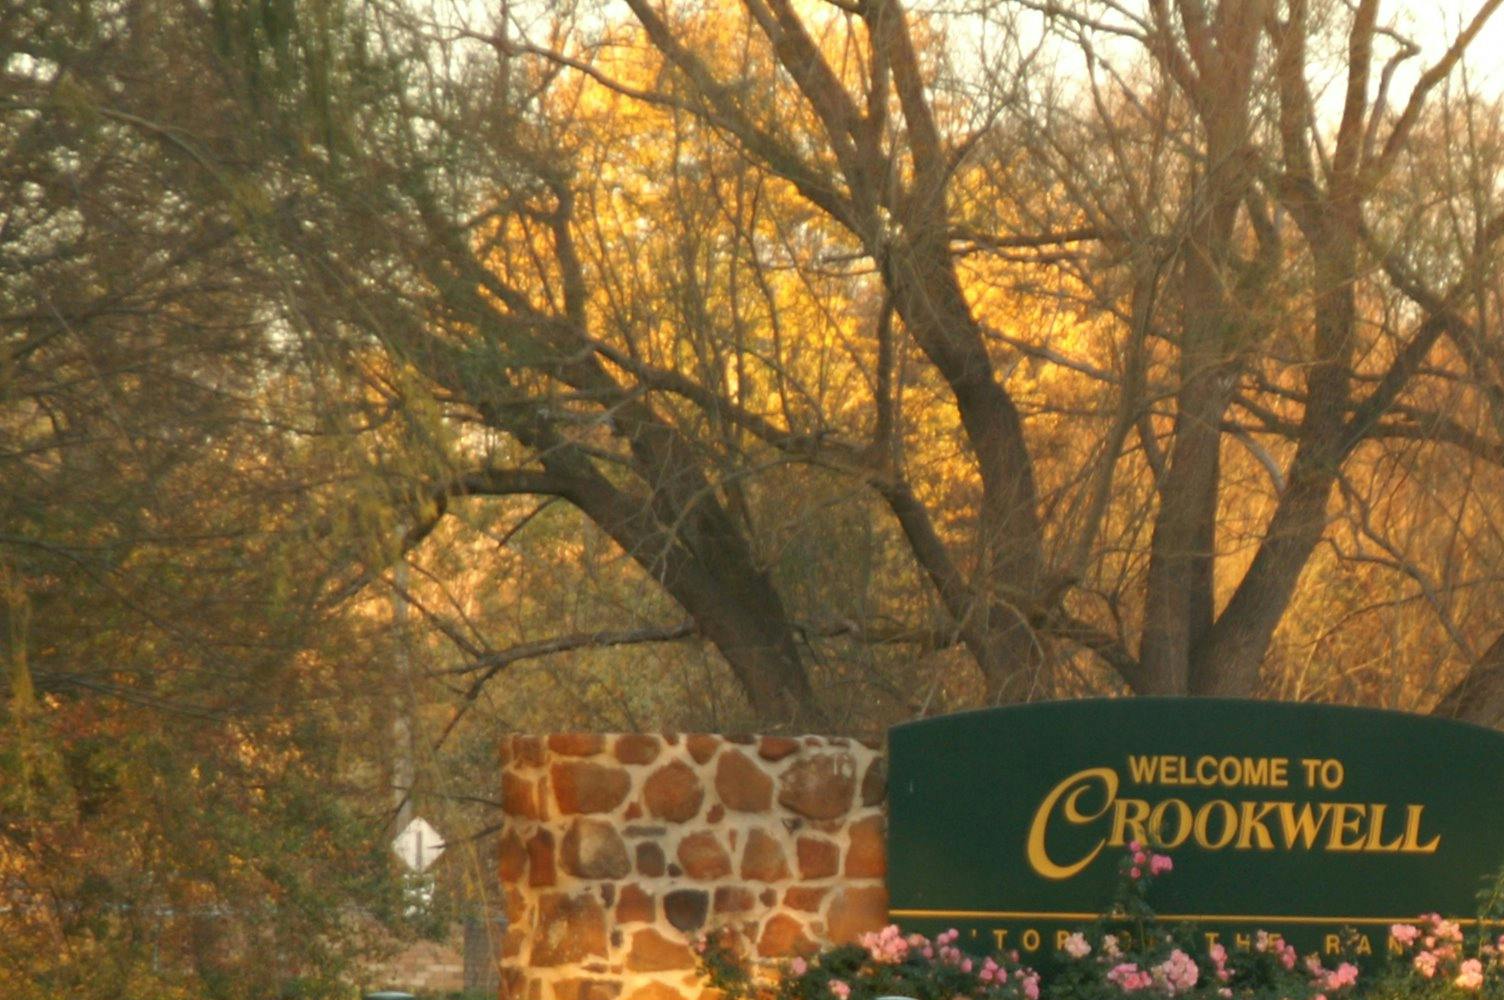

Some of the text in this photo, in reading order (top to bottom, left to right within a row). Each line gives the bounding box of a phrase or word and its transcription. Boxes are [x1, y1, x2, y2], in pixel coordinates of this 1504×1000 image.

[1128, 755, 1344, 789] WELCOME TO
[1026, 766, 1442, 881] CROOKWELL
[1204, 931, 1283, 954] THE
